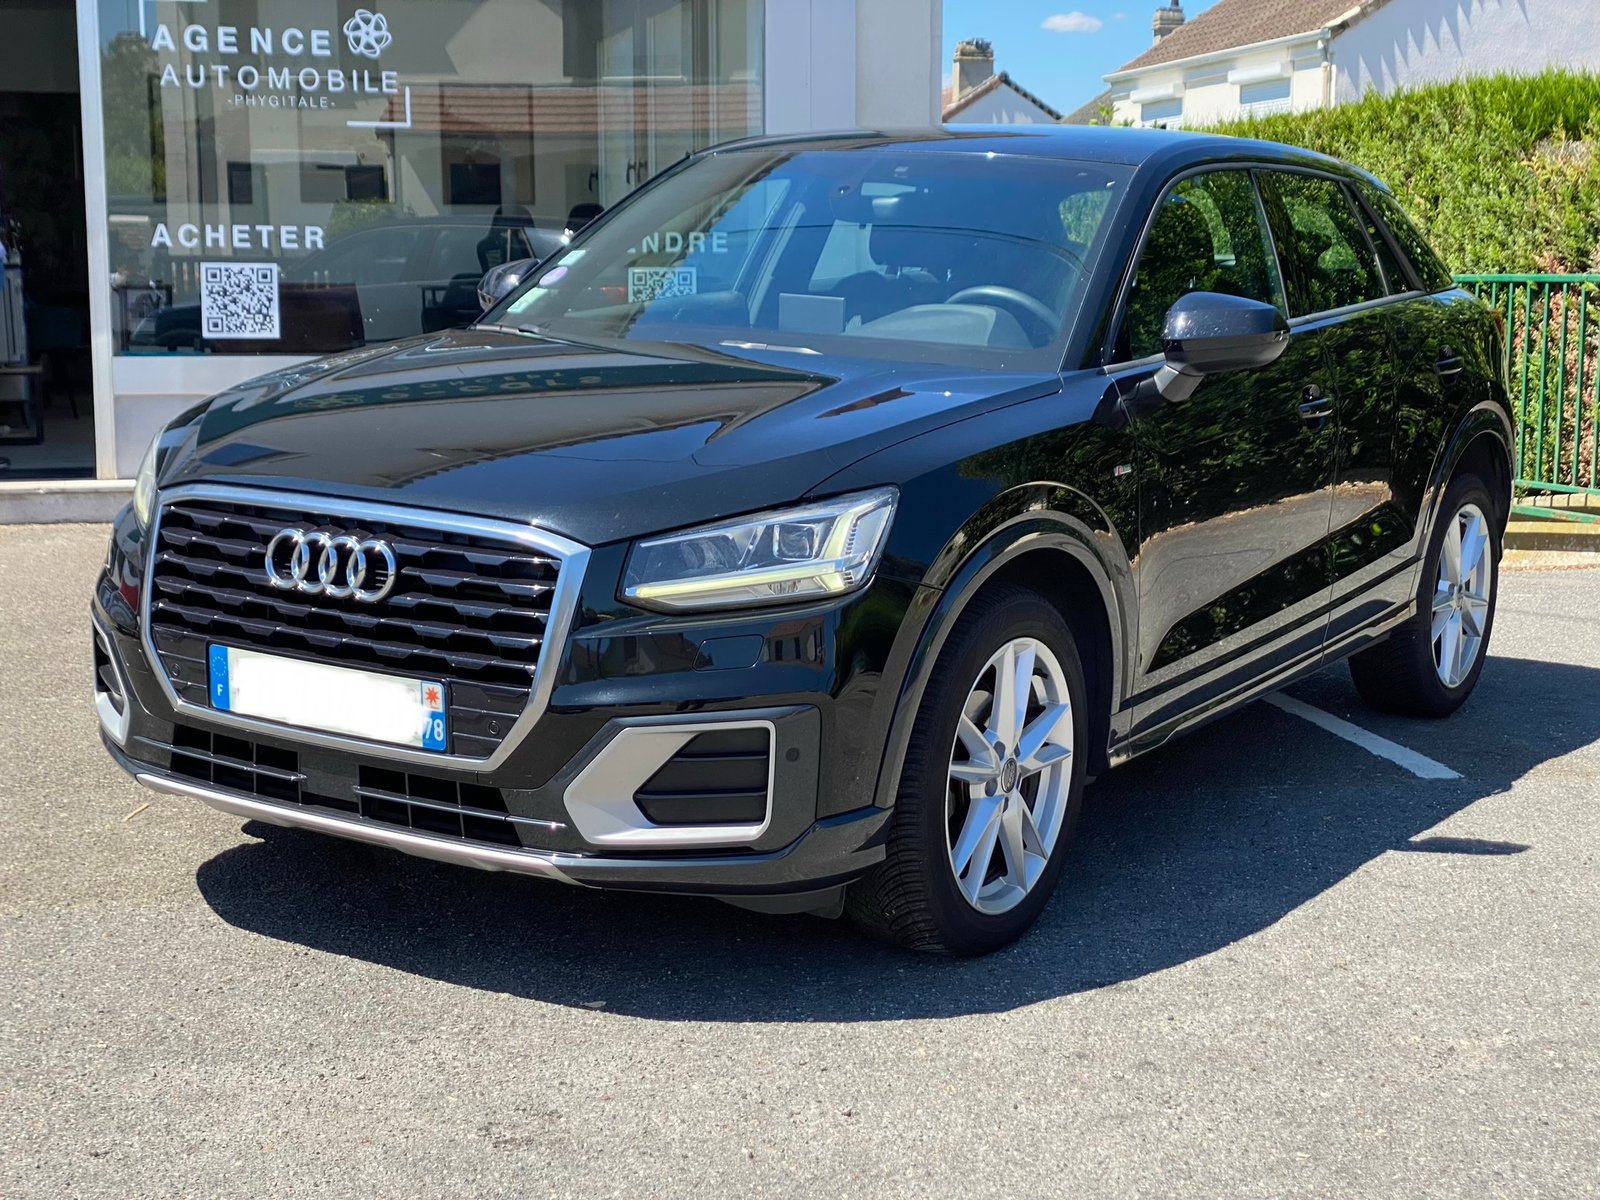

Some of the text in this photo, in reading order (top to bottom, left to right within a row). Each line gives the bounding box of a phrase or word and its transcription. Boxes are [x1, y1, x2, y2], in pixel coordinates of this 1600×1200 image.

[152, 23, 332, 56] AGENCE
[160, 63, 399, 94] AUTOMOBILE
[151, 223, 324, 249] ACHETER
[627, 231, 729, 253] NDRE
[216, 683, 224, 696] F
[423, 717, 444, 742] 78
